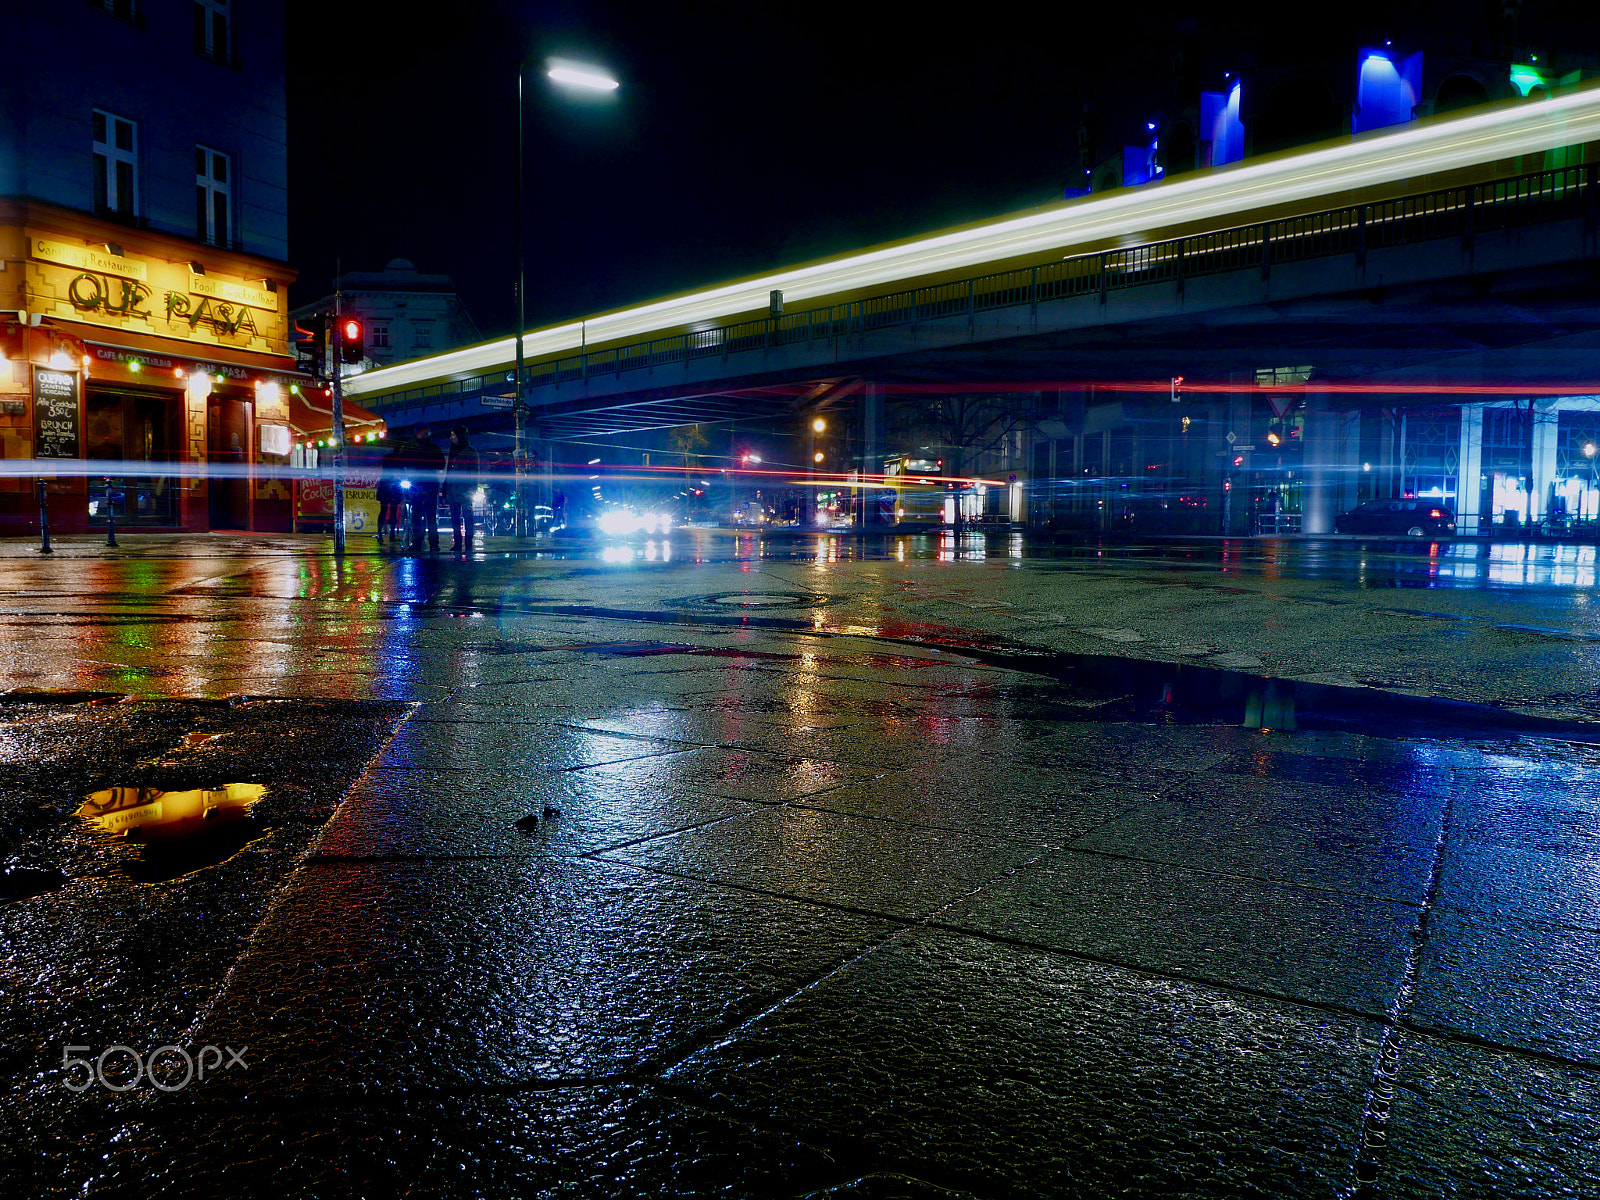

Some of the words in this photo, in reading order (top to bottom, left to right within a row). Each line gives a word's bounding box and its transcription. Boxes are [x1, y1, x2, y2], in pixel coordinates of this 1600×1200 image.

[70, 273, 152, 320] QUE
[164, 290, 259, 337] PASA
[195, 362, 217, 375] QUE
[221, 366, 248, 380] PASA
[41, 420, 73, 430] BRUNCH
[302, 486, 334, 501] Cockta
